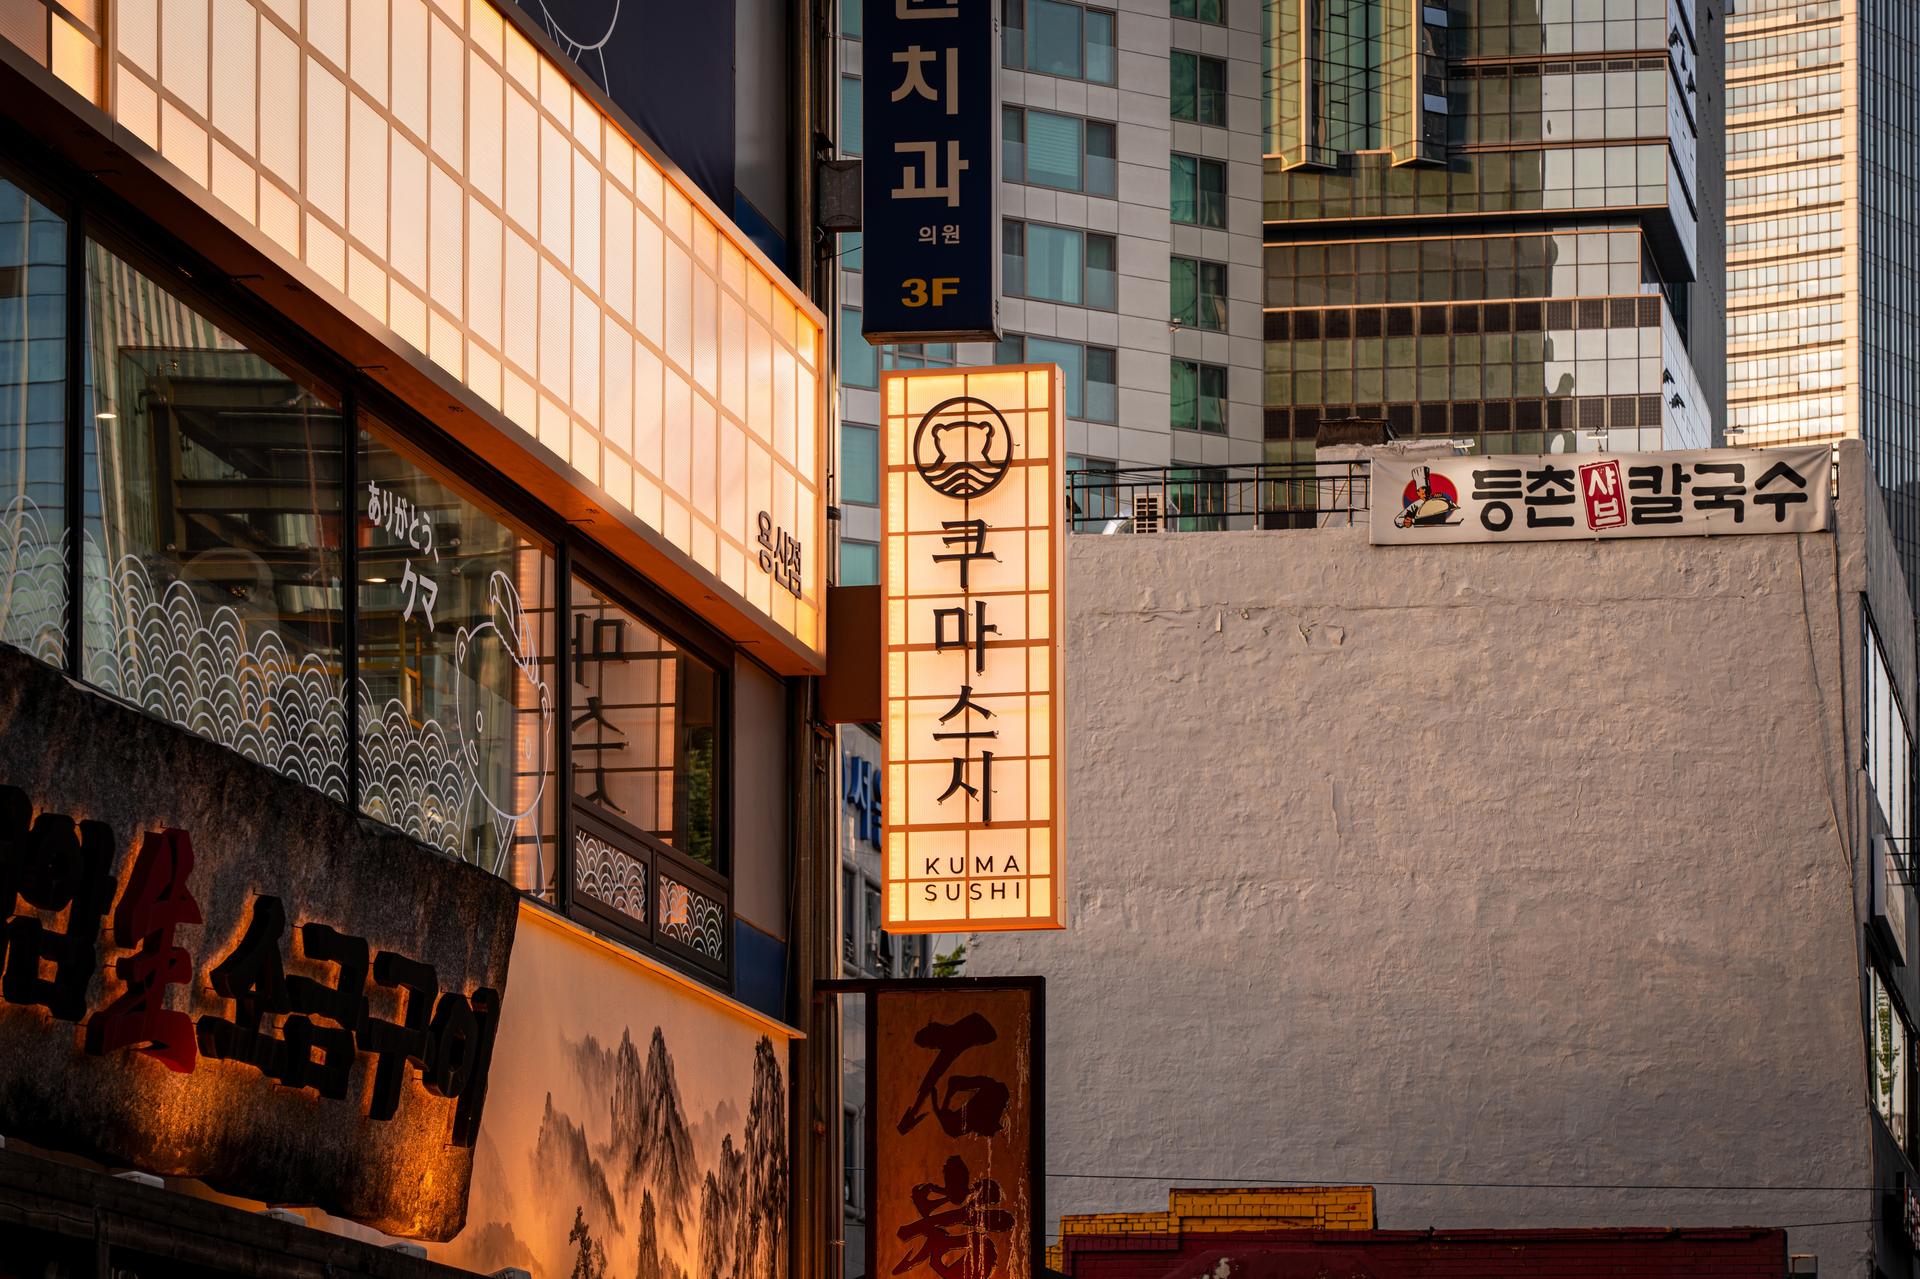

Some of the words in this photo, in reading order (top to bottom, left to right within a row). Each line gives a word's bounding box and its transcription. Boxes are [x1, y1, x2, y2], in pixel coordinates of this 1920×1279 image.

[918, 224, 961, 245] 의원
[901, 277, 961, 307] 3F
[1472, 464, 1576, 533] 등촌
[1588, 466, 1622, 526] 샤브
[1628, 460, 1809, 524] 칼국수
[757, 510, 802, 600] 용산점
[401, 558, 438, 632] クマ
[932, 518, 1003, 826] 쿠마스시
[925, 855, 1020, 876] KUMA
[924, 881, 1021, 902] SUSHI
